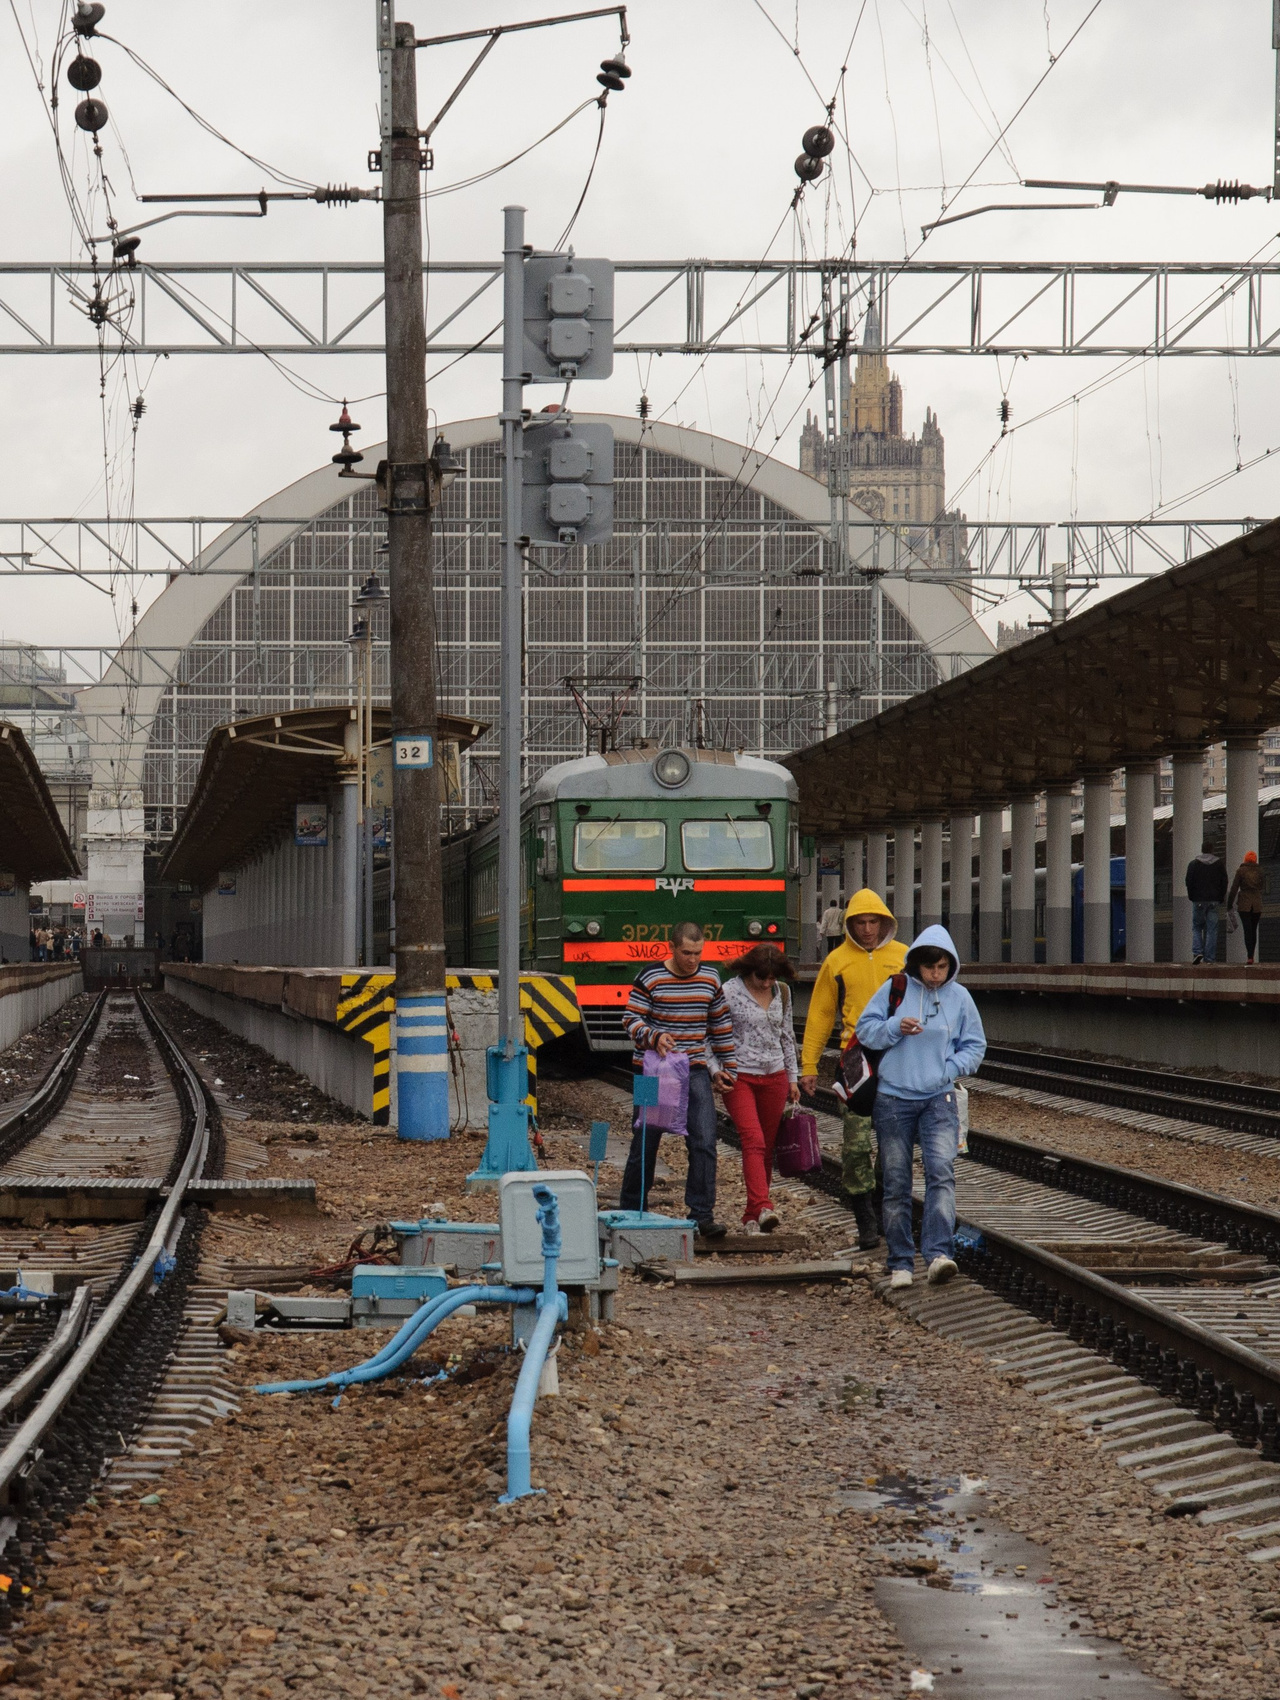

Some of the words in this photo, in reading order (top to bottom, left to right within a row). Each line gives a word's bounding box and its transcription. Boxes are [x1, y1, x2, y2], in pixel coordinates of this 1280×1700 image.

[400, 746, 420, 759] 32
[655, 877, 695, 898] RVR
[621, 924, 724, 941] ЭР2Т57
